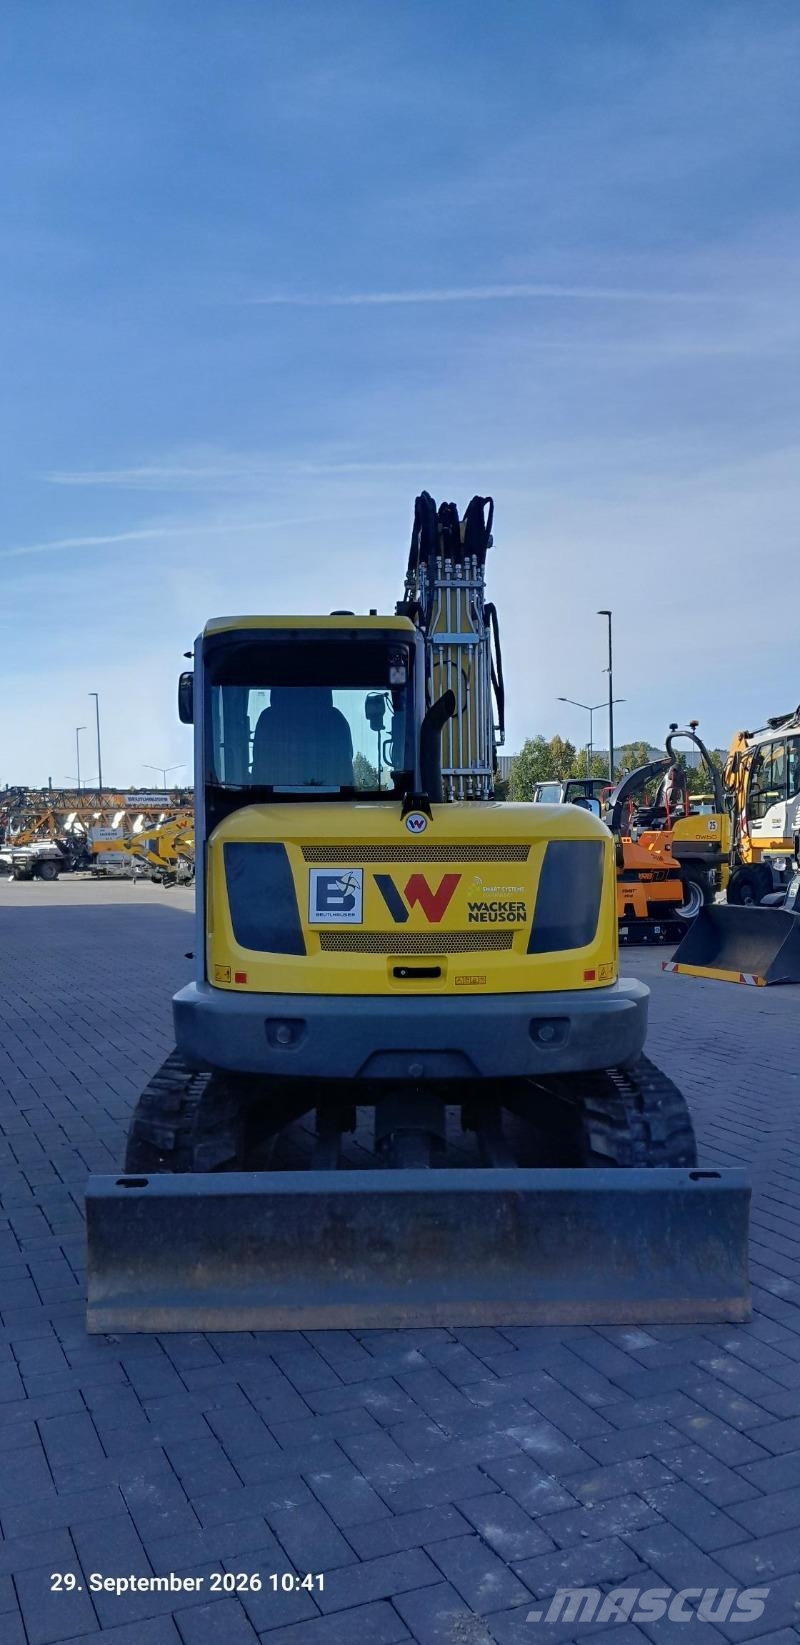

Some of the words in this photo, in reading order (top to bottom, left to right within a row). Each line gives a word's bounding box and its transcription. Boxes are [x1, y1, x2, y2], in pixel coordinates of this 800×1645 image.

[709, 821, 716, 830] 25
[372, 873, 463, 923] W
[467, 901, 526, 912] WACKER
[468, 911, 527, 922] NEUSON
